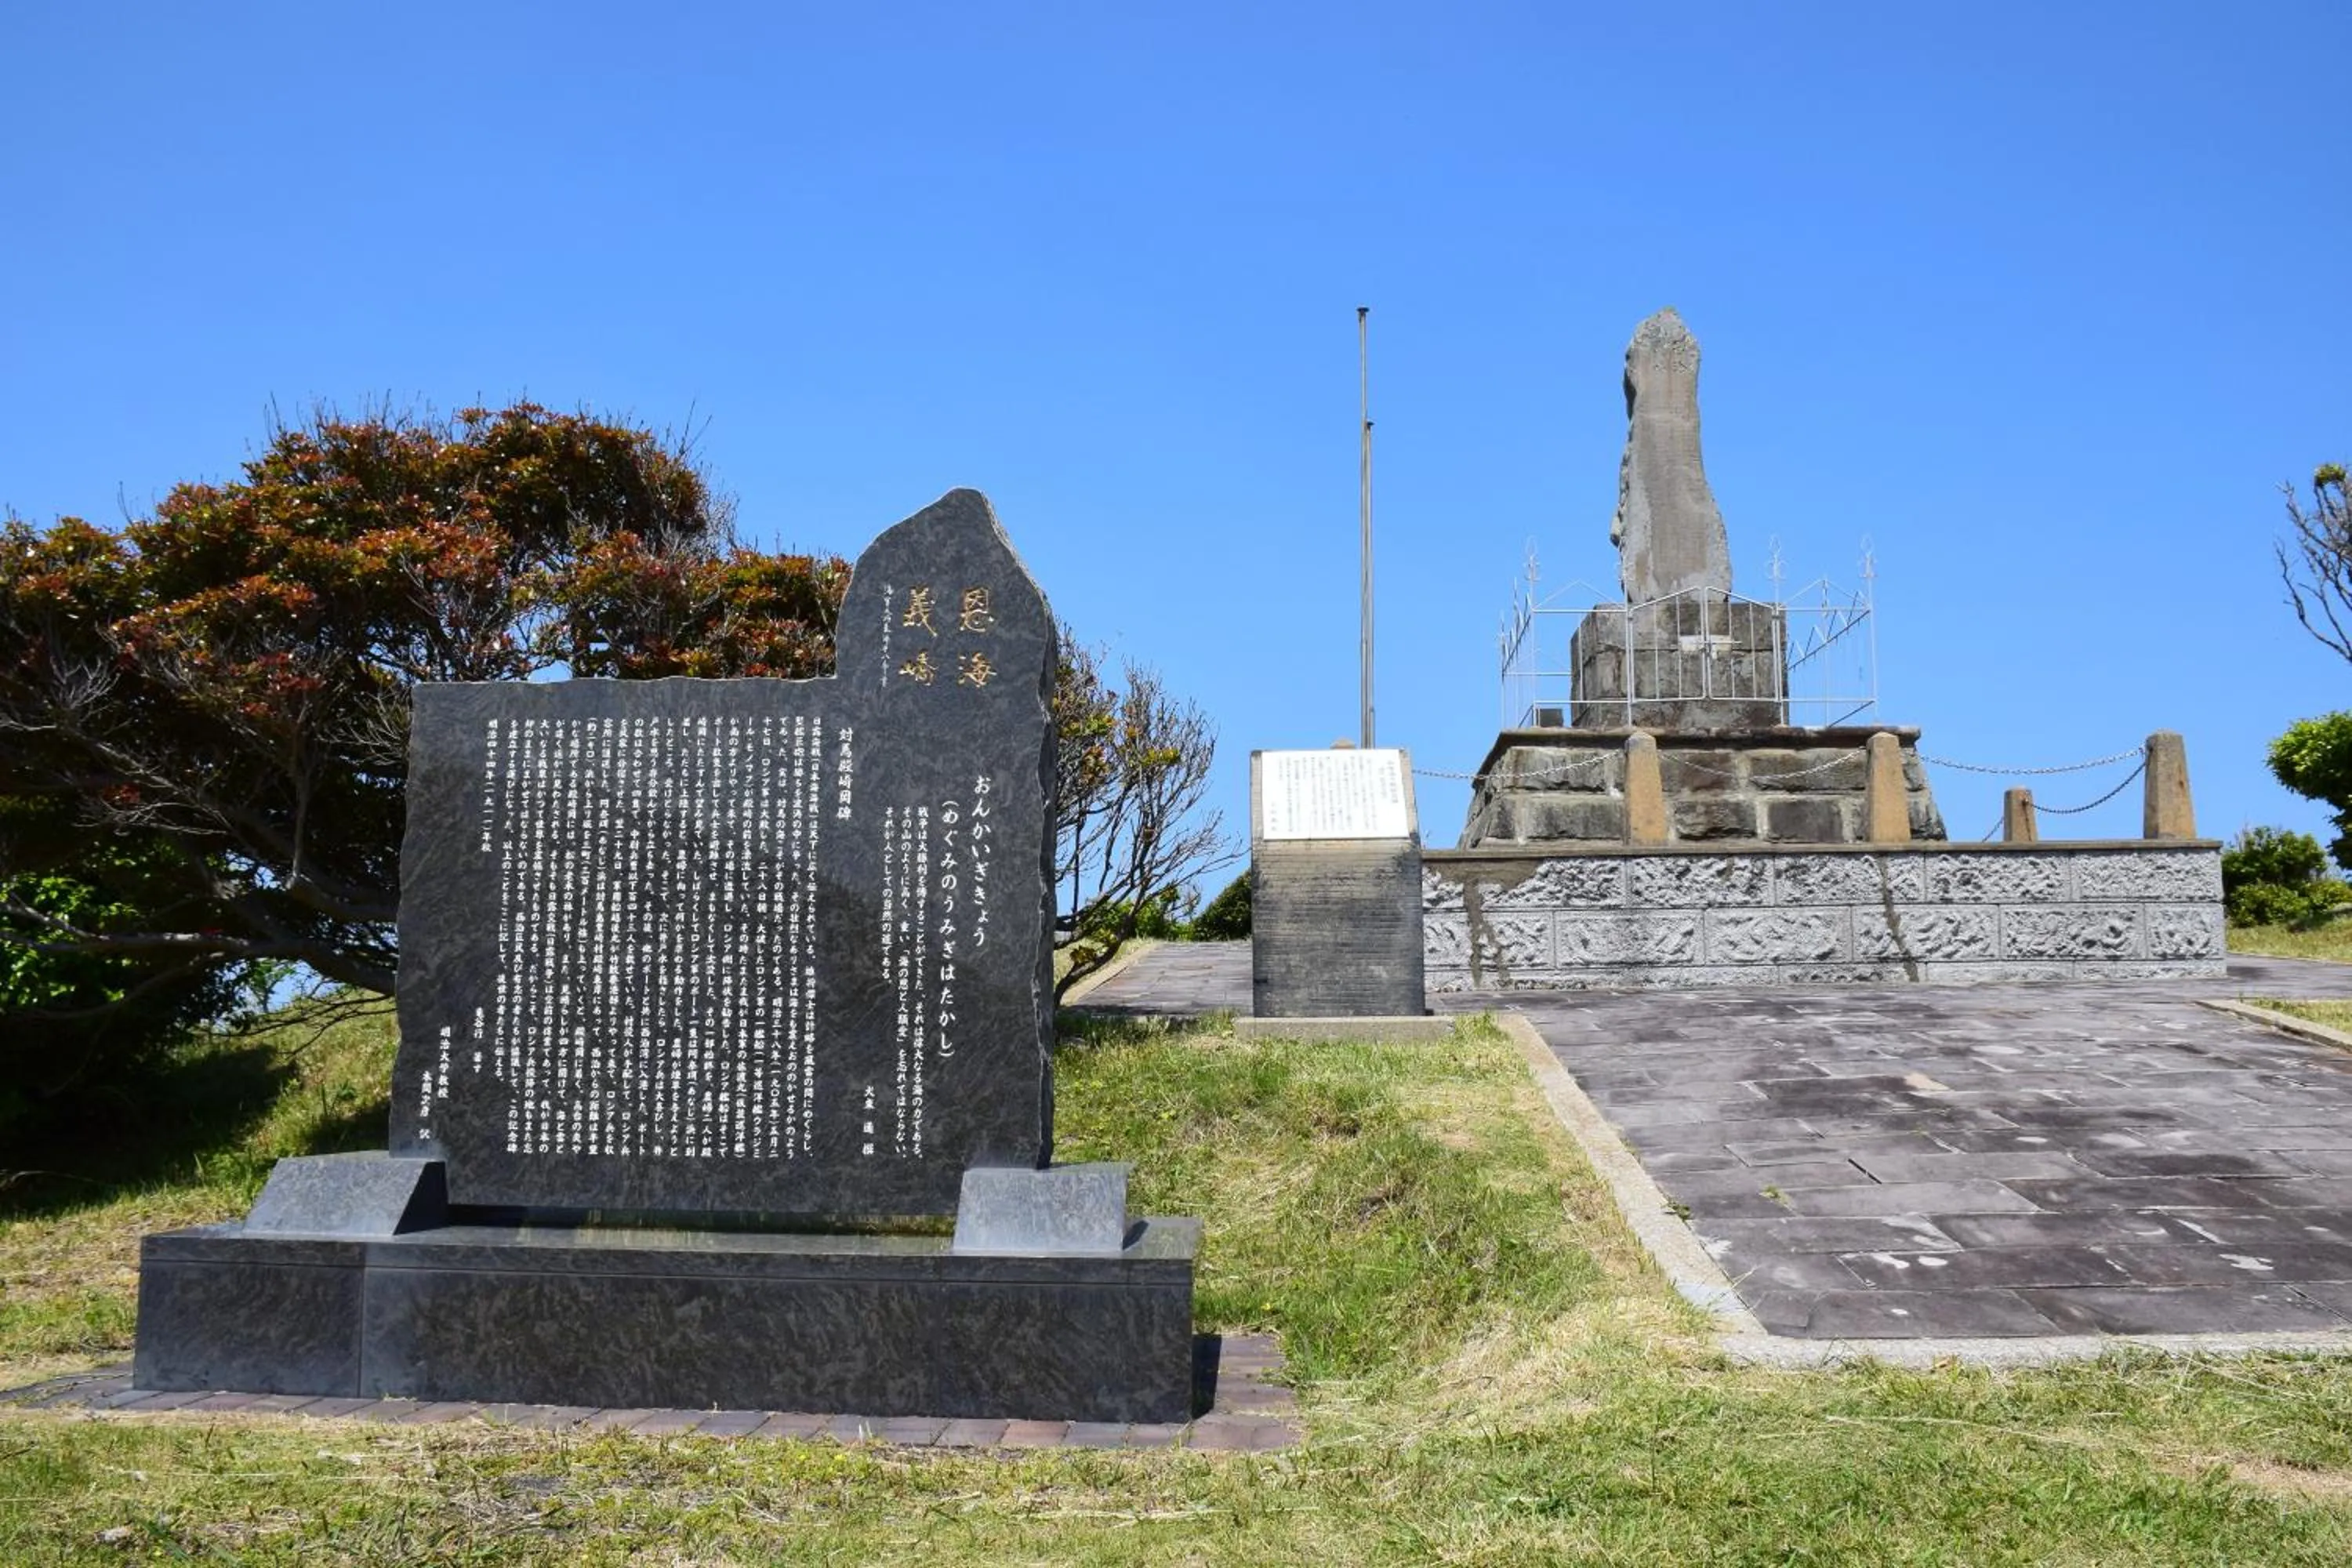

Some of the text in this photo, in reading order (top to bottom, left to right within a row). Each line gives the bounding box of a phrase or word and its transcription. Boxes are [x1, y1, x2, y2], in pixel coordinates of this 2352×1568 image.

[881, 807, 895, 984] それが人としての当然の道である。
[938, 800, 959, 1058] （めぐみのうみぎはたかし）
[971, 775, 992, 947] おんかいぎきょう
[437, 1026, 451, 1098] 明治大学教授
